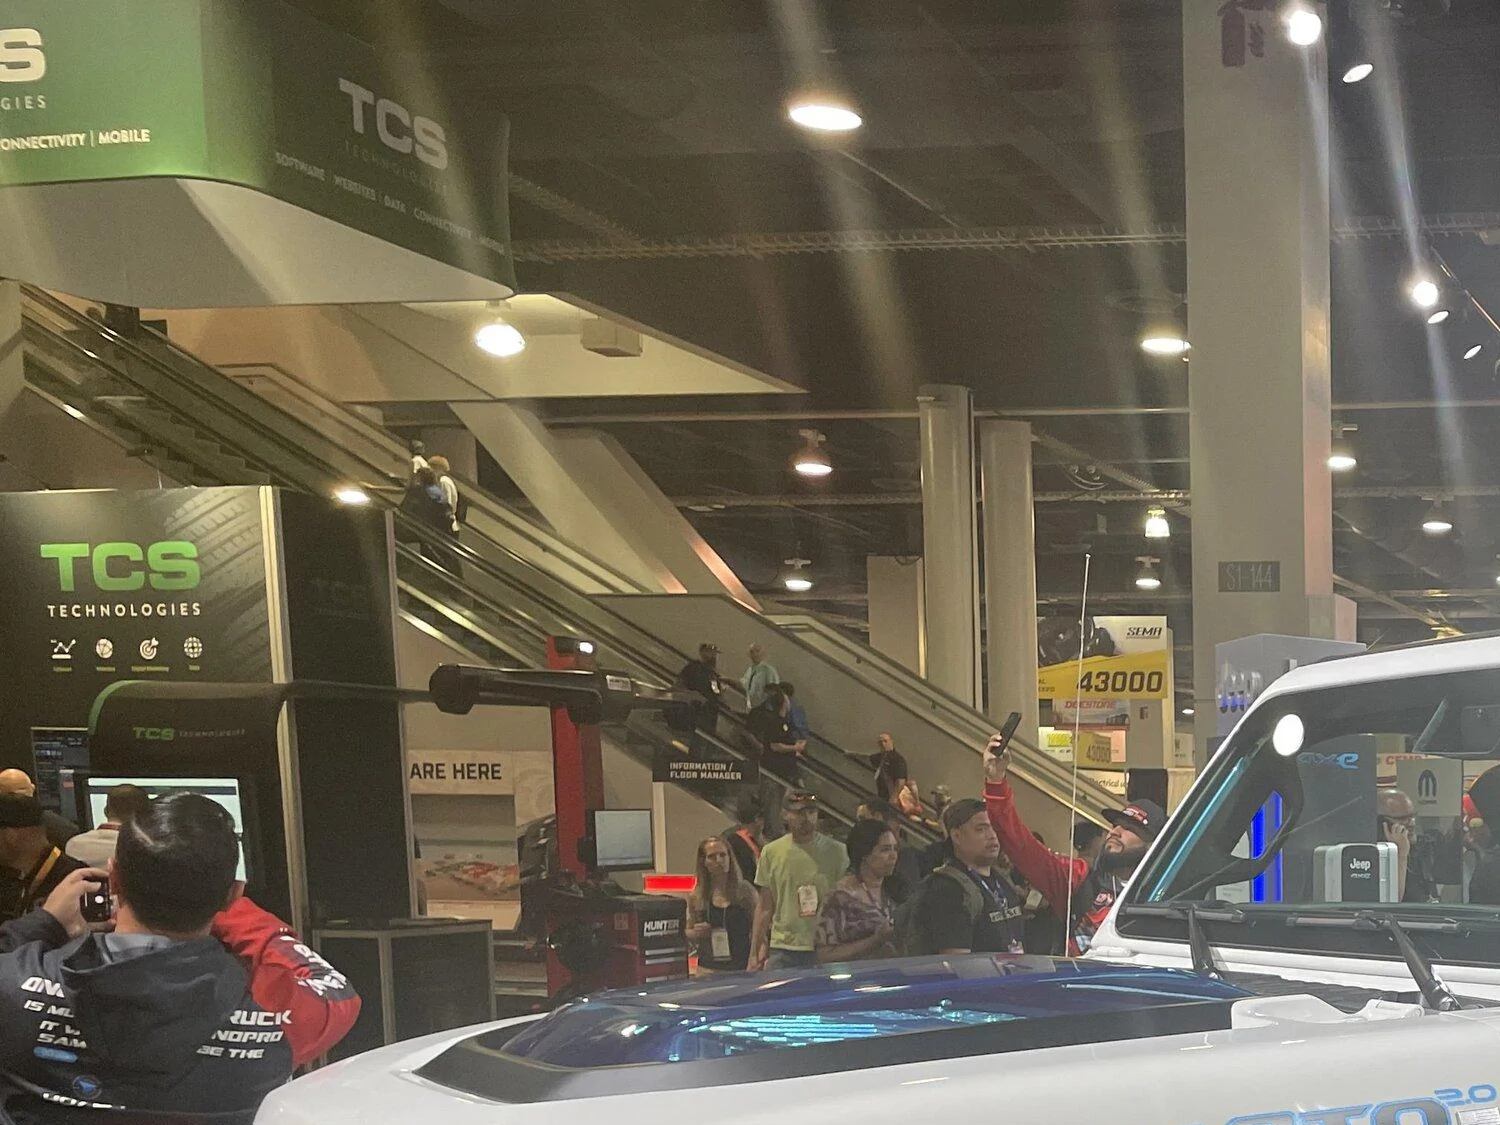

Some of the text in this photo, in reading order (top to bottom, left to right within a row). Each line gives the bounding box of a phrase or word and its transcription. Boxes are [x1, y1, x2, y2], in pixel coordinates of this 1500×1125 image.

[338, 77, 448, 170] TCS
[0, 129, 151, 150] ONNECTIVITY MOBILE
[40, 541, 201, 592] TCS
[47, 602, 201, 618] TECHNOLOGIES
[1126, 626, 1163, 637] SEMA
[1077, 670, 1164, 693] 43000
[409, 762, 503, 781] ARE HERE
[669, 762, 727, 771] INFORMATION
[670, 771, 742, 781] FLOOR MANAGER
[1349, 858, 1371, 871] Jeep
[643, 919, 680, 933] HUNTER
[228, 1048, 265, 1059] THE
[1433, 1084, 1498, 1106] 2.0
